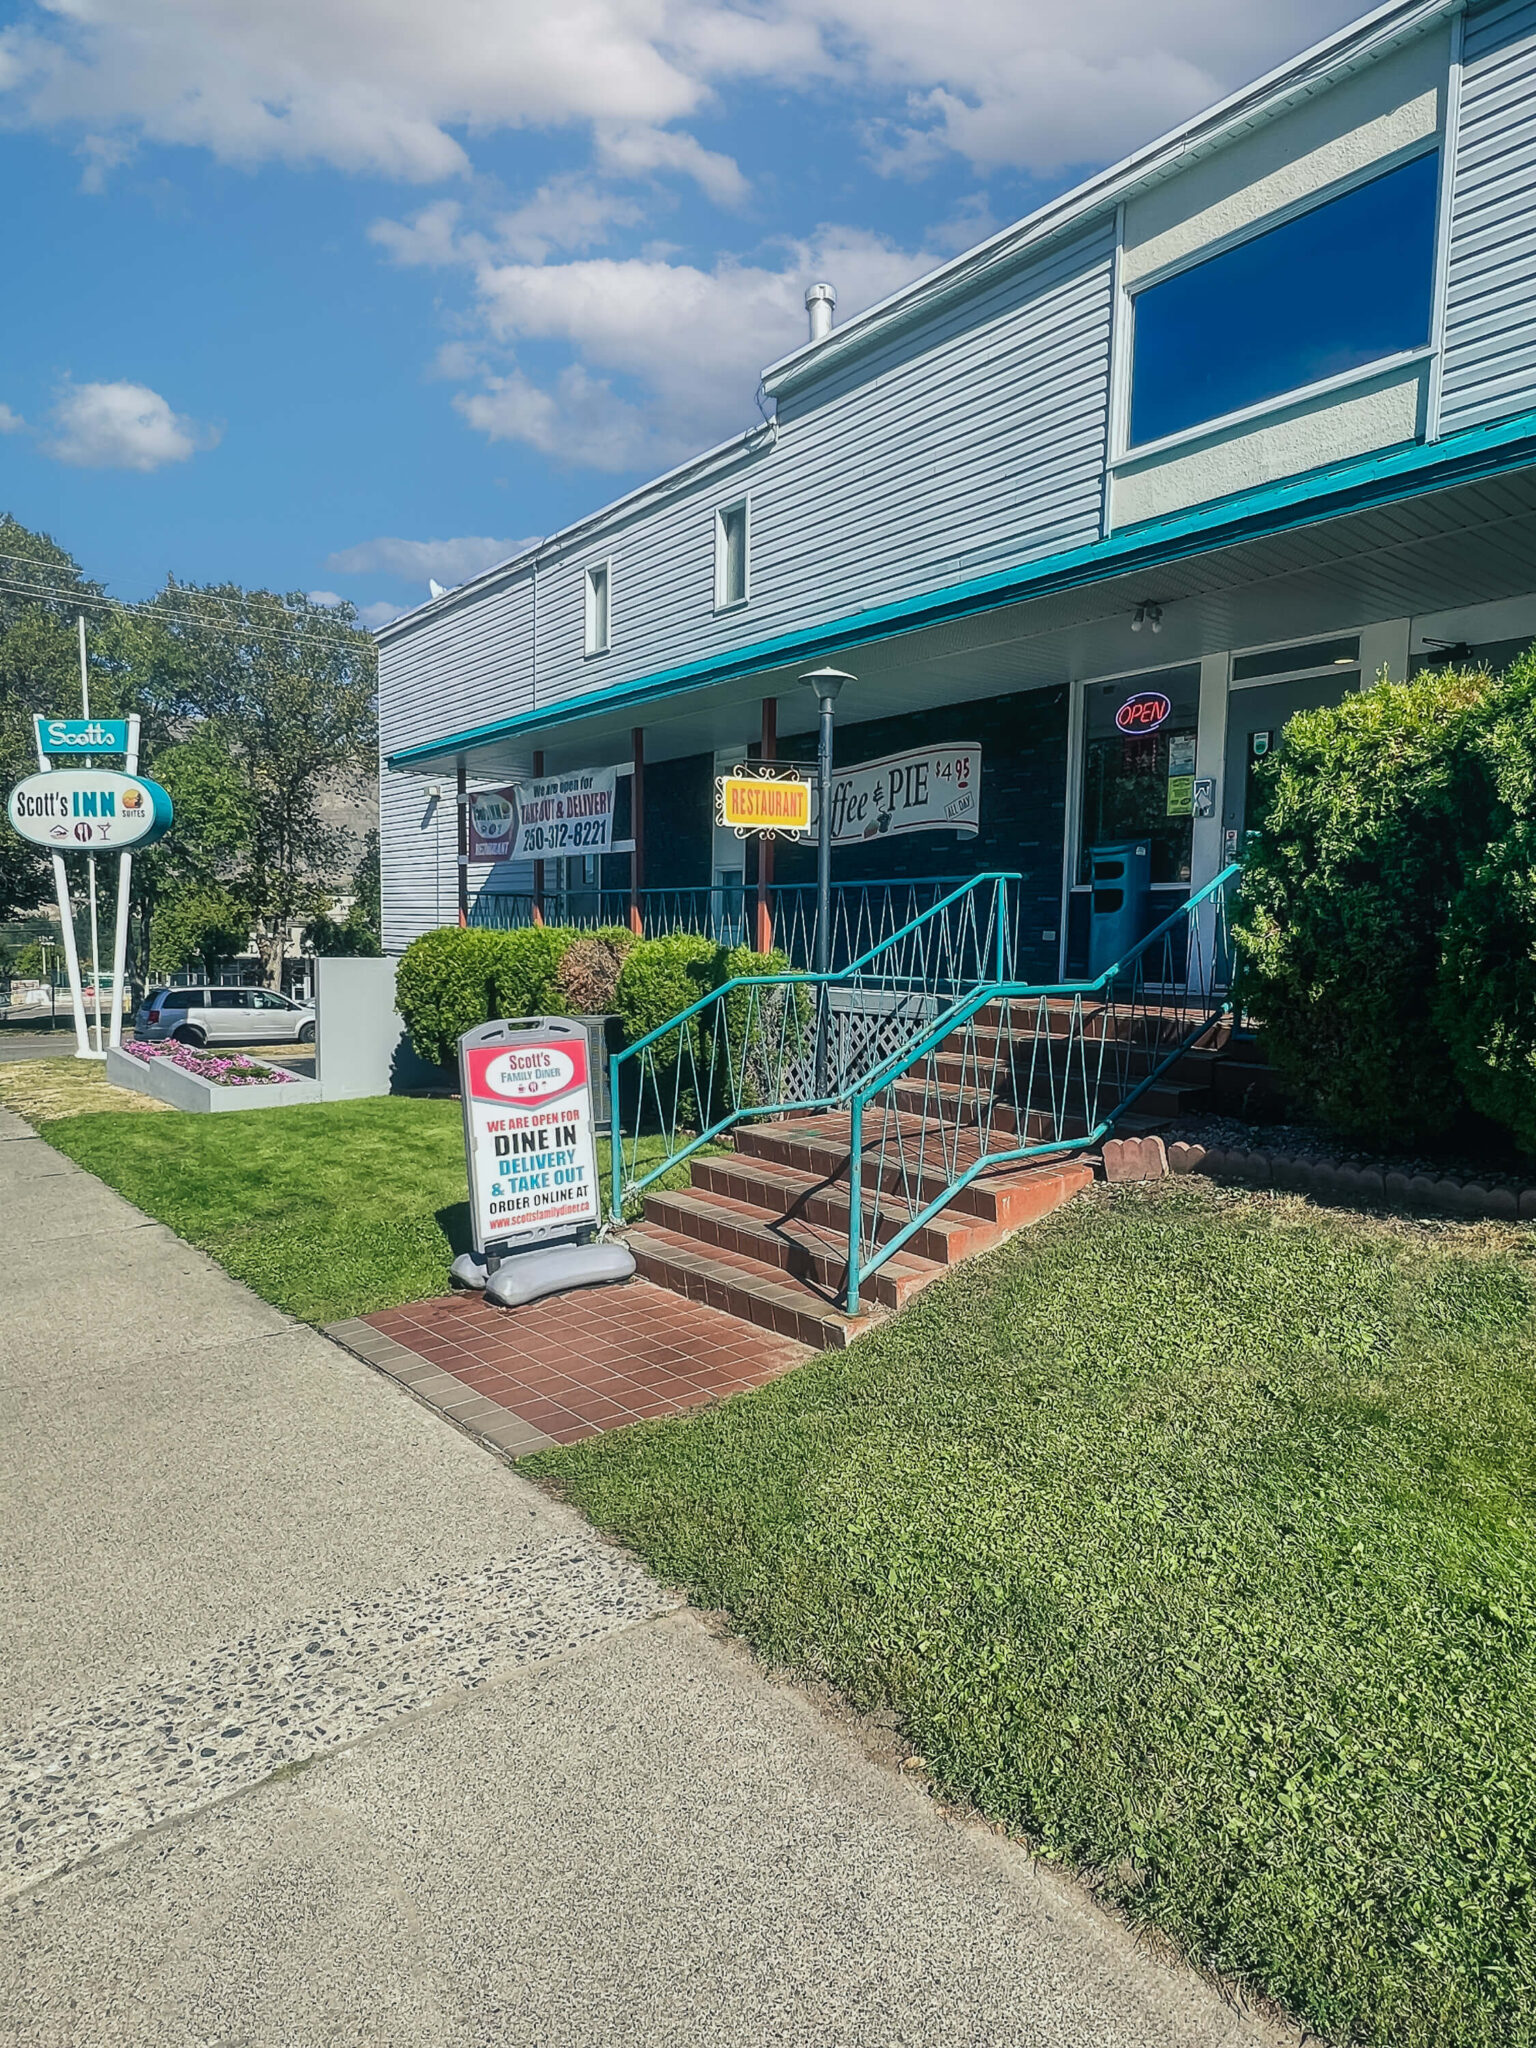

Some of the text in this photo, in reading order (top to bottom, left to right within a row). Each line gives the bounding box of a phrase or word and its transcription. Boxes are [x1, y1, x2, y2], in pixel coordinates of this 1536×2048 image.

[1119, 700, 1166, 726] OPEN
[534, 775, 593, 798] We are open for
[811, 762, 930, 837] ffee & PIE
[17, 791, 116, 818] Scott's INN
[122, 810, 146, 818] SUITES
[556, 801, 564, 818] &
[567, 790, 612, 818] DELIVERY
[731, 788, 804, 818] RESTAURANT
[947, 795, 970, 818] ALL DAY
[523, 819, 607, 852] 250-312-8221
[509, 1052, 551, 1070] Scott's
[501, 1067, 561, 1083] FAMILY DINER
[487, 1109, 580, 1133] WE ARE OPEN FOR
[495, 1124, 577, 1157] DINE IN
[499, 1149, 576, 1176] DELIVERY
[491, 1166, 585, 1197] & TAKE OUT
[490, 1185, 589, 1214] ORDER ONLINE AT
[489, 1201, 590, 1230] www.scottsfamilydiner.ca
